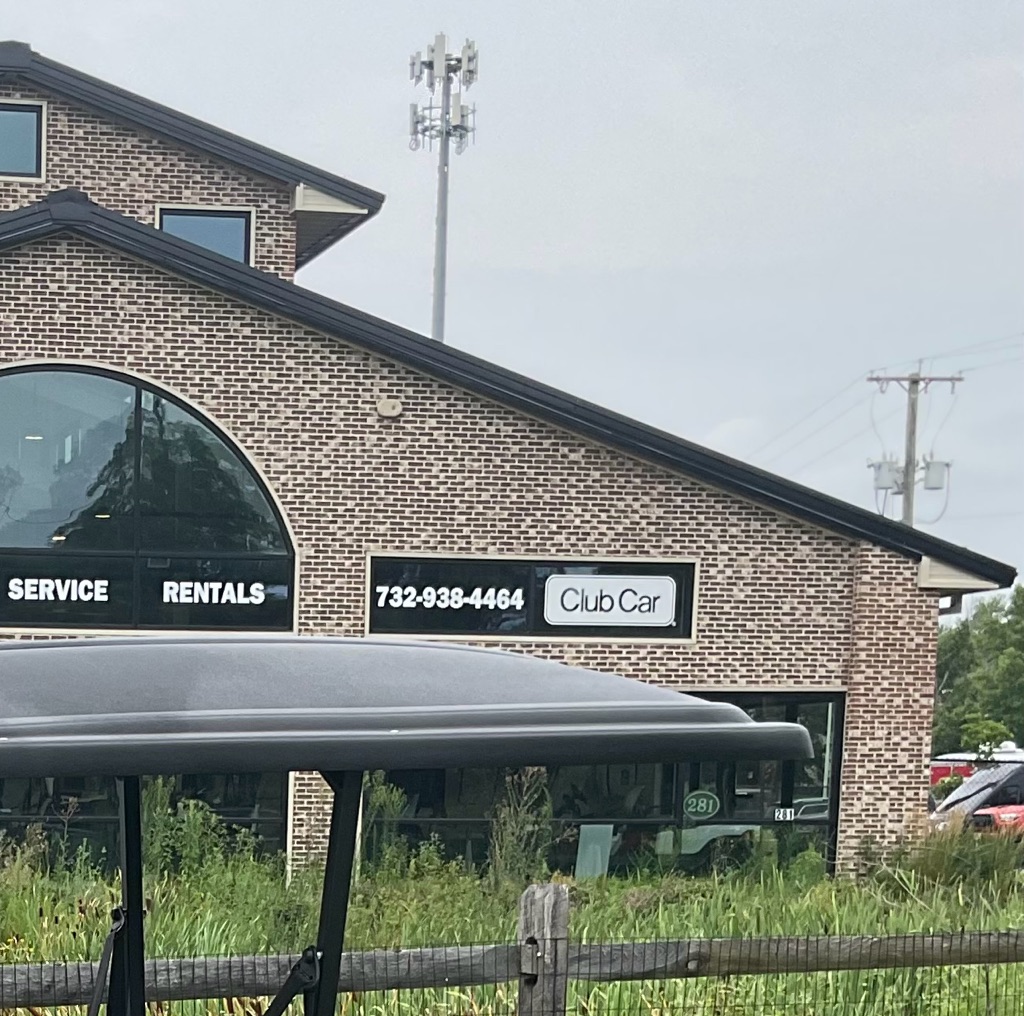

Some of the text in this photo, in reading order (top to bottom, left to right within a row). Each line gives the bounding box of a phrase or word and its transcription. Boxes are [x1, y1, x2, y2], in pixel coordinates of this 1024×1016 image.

[7, 577, 109, 602] SERVICE
[162, 581, 265, 605] RENTALS
[376, 586, 525, 610] 732-938-4464
[560, 587, 661, 613] Club Car
[687, 798, 714, 813] 281
[775, 809, 794, 820] 281
